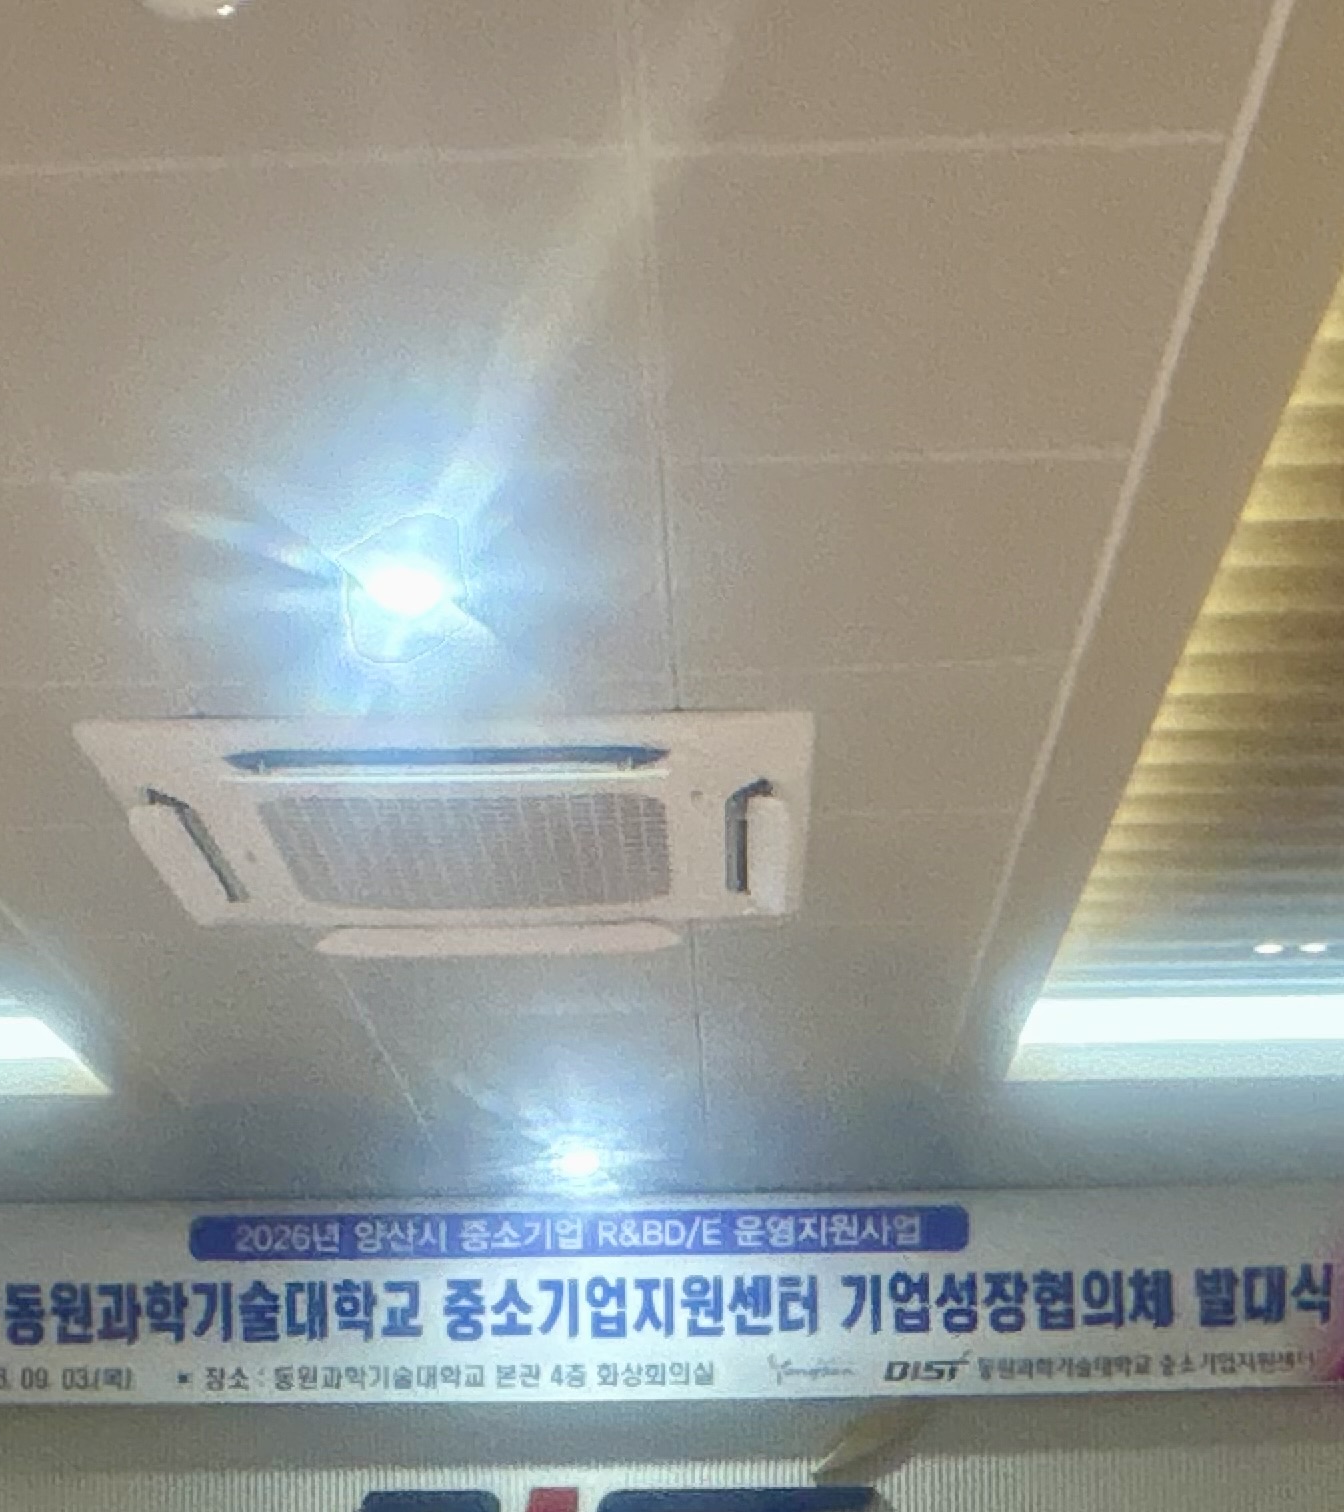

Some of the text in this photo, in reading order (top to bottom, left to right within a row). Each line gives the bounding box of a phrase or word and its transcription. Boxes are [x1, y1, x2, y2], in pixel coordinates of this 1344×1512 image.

[235, 1213, 922, 1253] 2026년 양산시 중소기업 R&BD/E 운영지원사업
[443, 1273, 818, 1341] 중소기업지원센터
[840, 1267, 1174, 1334] 기업성장협의체
[1194, 1263, 1333, 1327] 발대식
[884, 1353, 972, 1381] DIST
